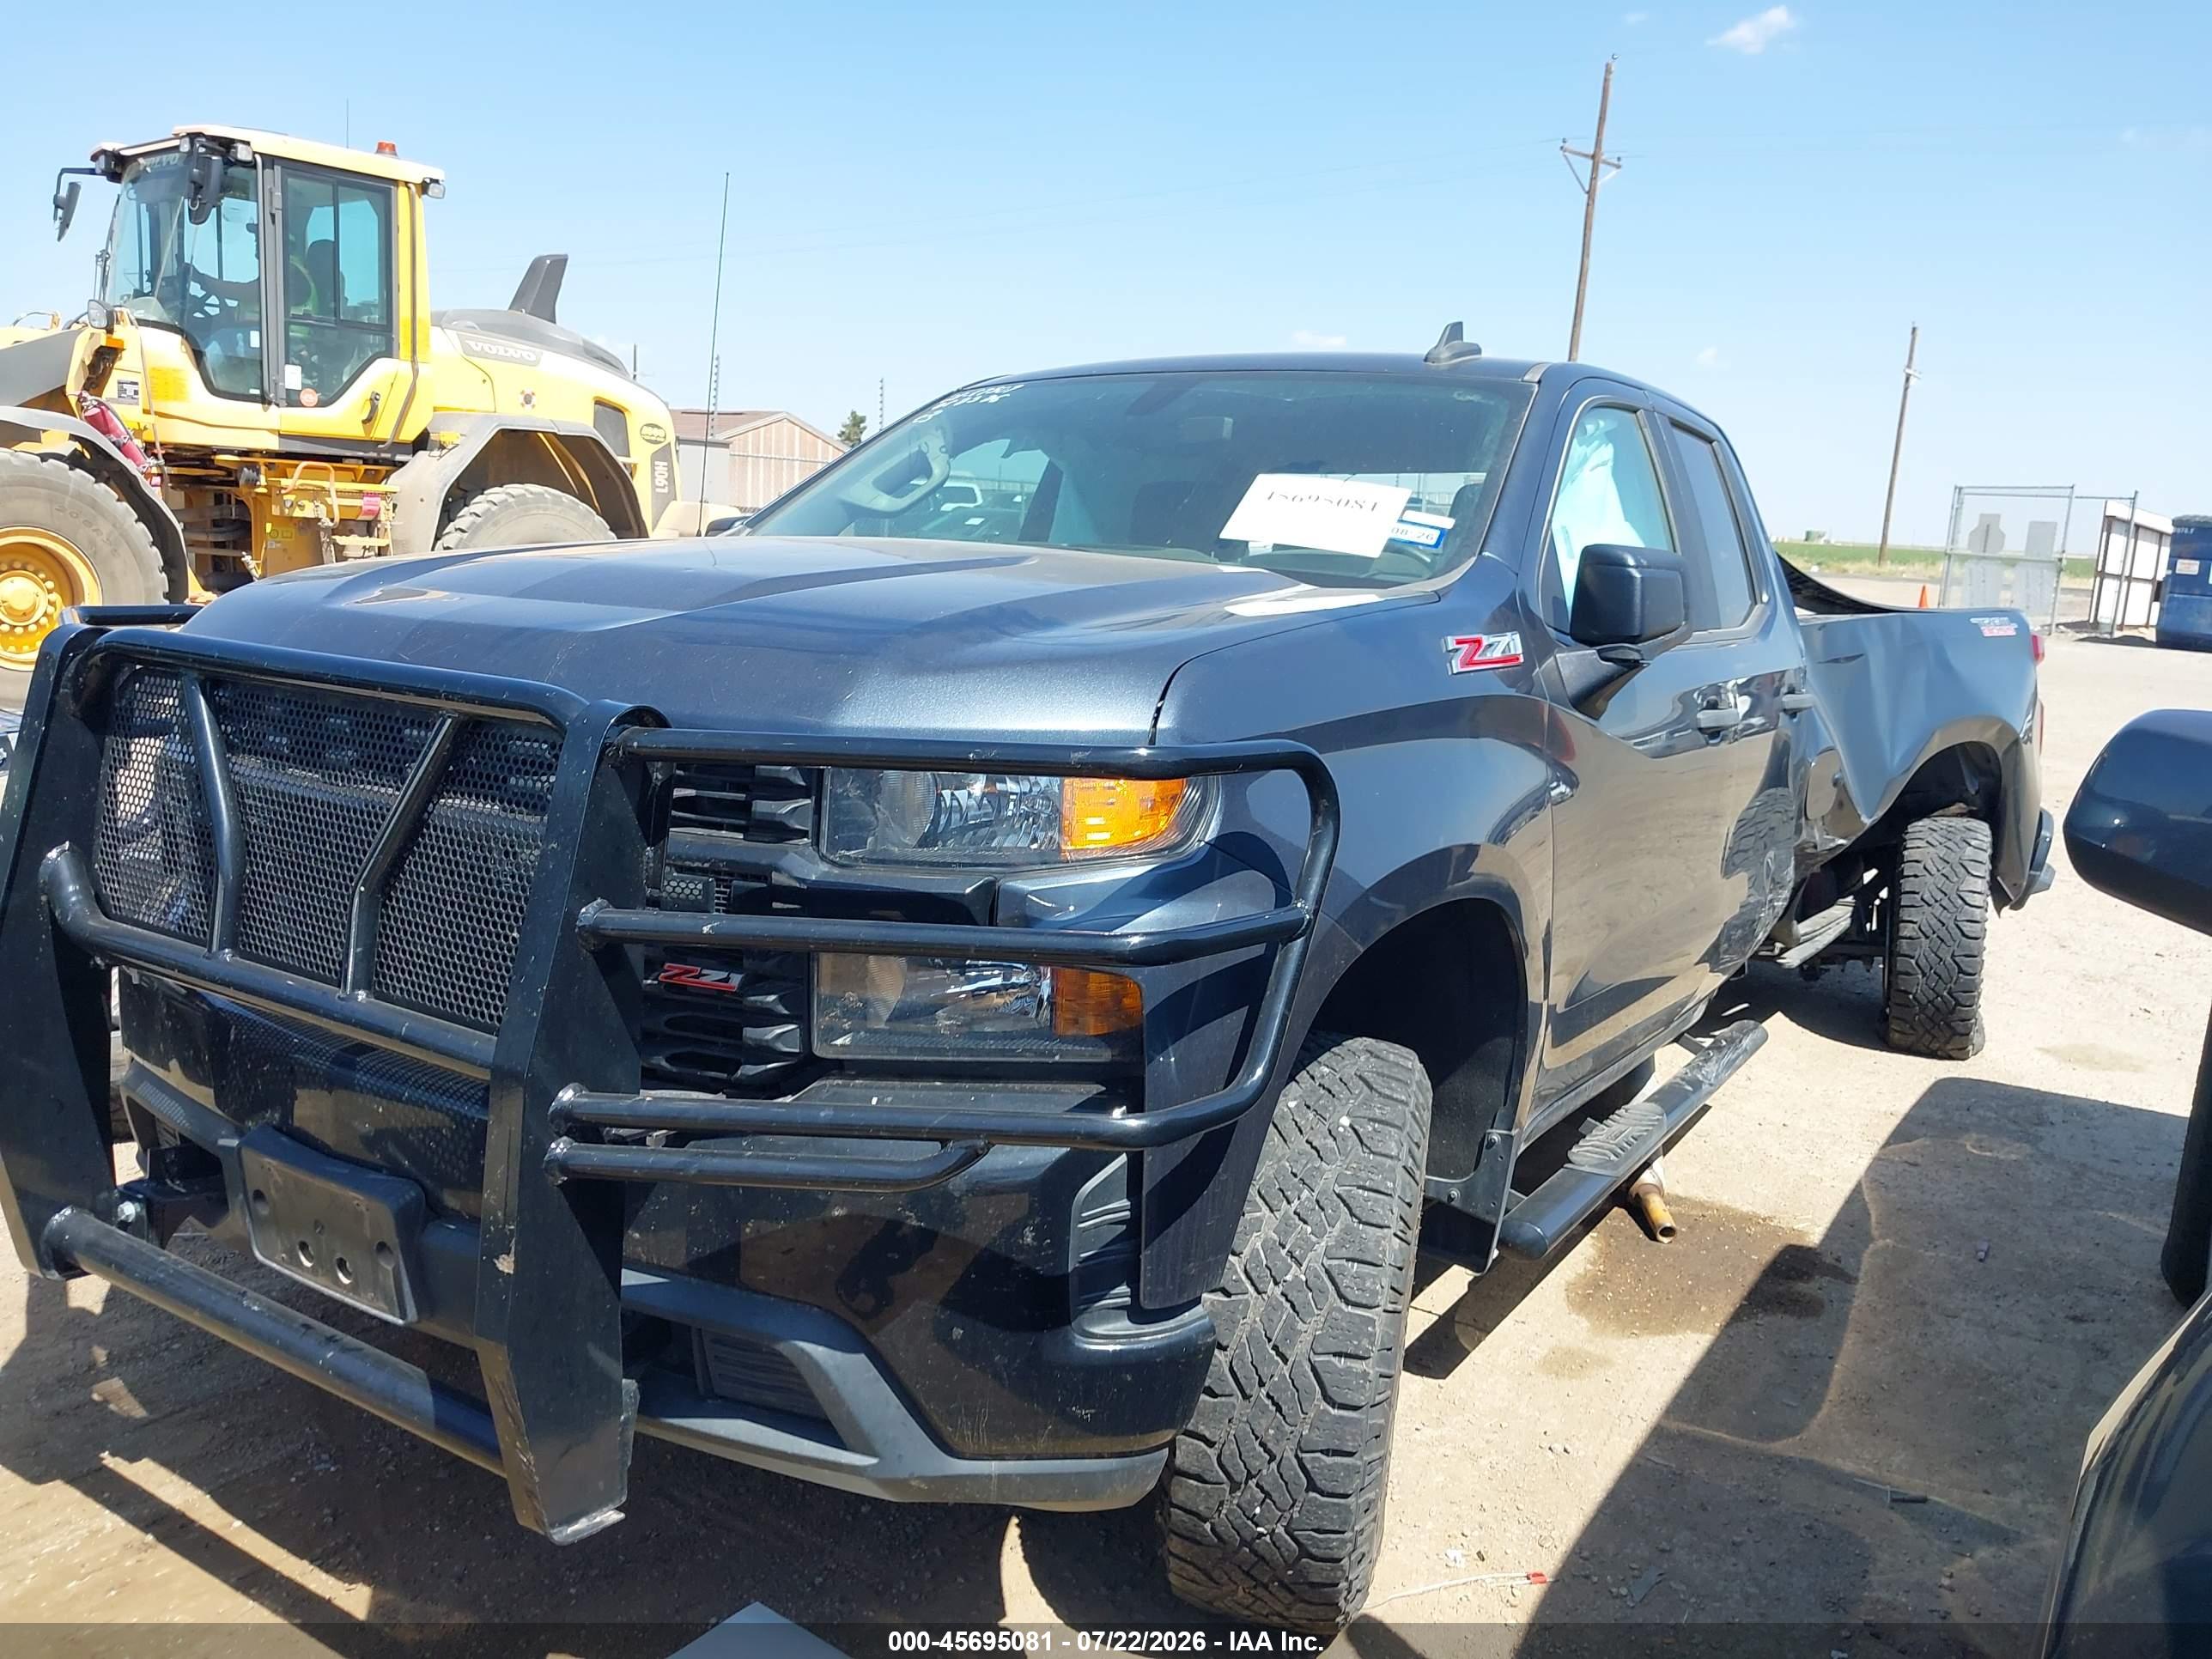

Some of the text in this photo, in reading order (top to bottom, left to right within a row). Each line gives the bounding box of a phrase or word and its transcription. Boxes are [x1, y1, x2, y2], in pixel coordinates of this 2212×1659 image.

[465, 340, 536, 362] VOLVO
[654, 460, 669, 494] L90H
[1444, 631, 1524, 674] Z71
[659, 963, 744, 992] Z71
